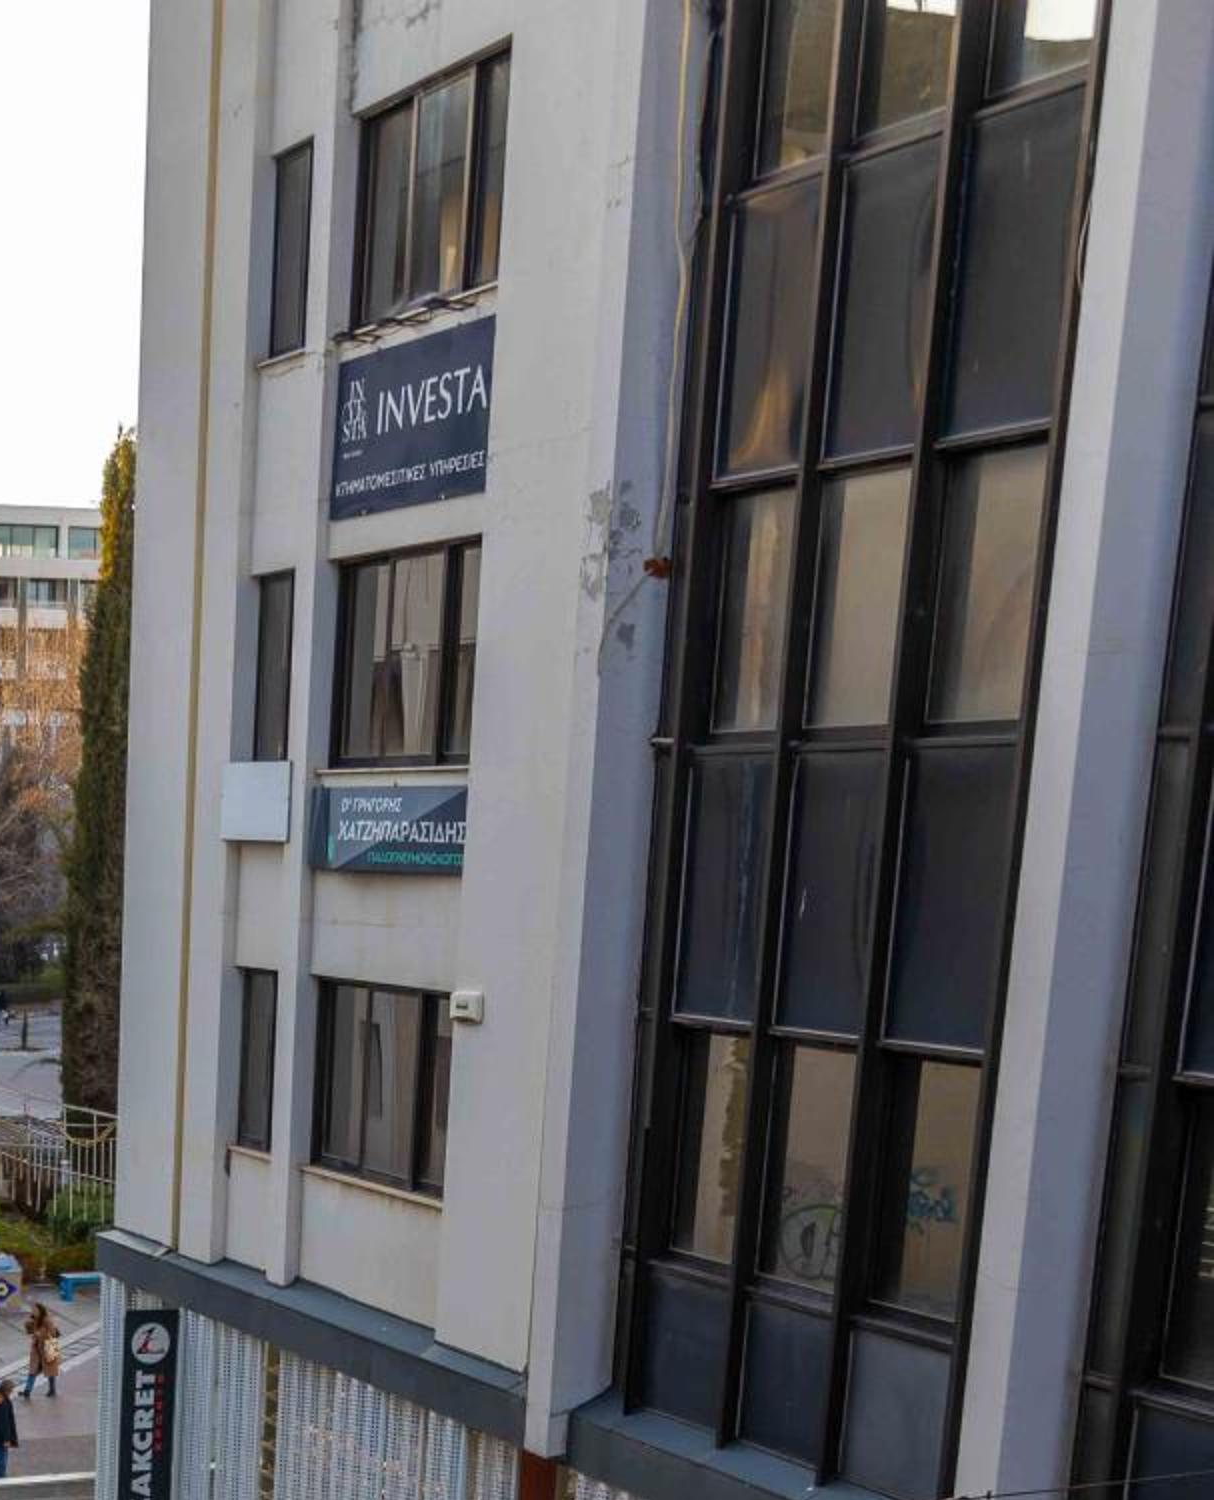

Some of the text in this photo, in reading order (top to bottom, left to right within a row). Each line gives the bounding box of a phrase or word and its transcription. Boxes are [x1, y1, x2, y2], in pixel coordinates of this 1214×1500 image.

[377, 364, 486, 435] INVESTA
[430, 451, 484, 478] ΥΠΗΡΕΣΙΕΣ
[338, 820, 466, 843] ΧΑΤΖΗΠΑΡΑΣΙΔΗΣ
